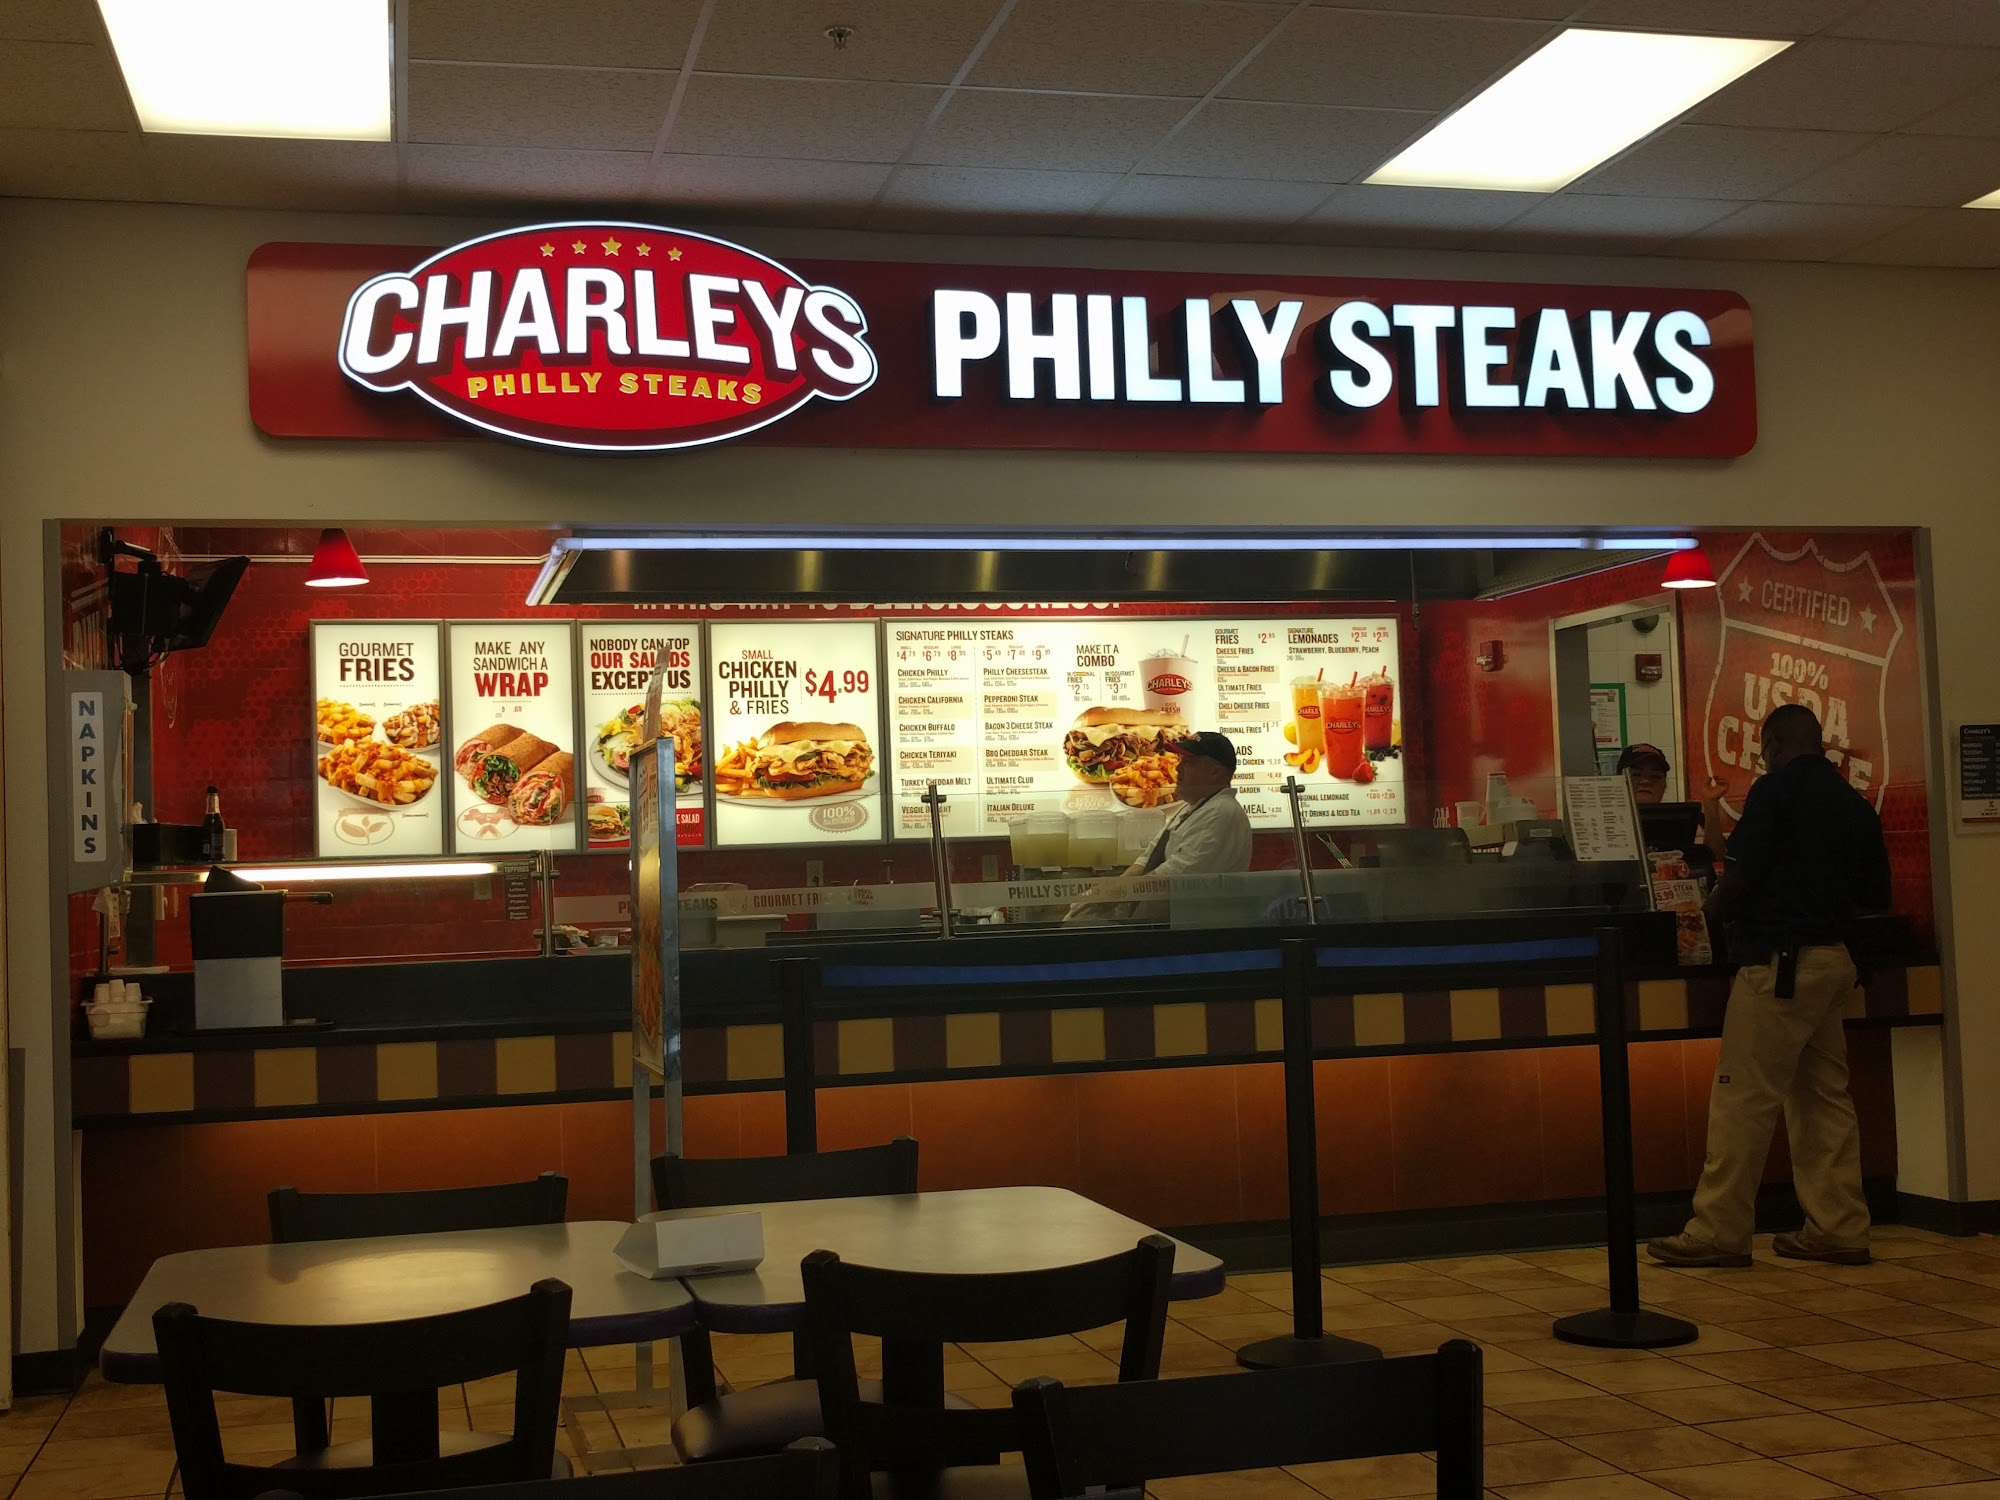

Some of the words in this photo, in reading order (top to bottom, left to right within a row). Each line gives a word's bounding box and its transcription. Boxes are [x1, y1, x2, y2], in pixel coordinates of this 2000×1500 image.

[348, 267, 875, 385] CHARLEYS
[933, 289, 1304, 404] PHILLY
[1327, 300, 1715, 414] STEAKS
[467, 372, 602, 398] PHILLY
[620, 373, 763, 405] STEAKS
[1760, 580, 1851, 627] CERTIFIED
[896, 630, 945, 641] SIGNATURE
[947, 630, 978, 640] PHILLY
[980, 630, 1014, 640] STEAKS
[1215, 634, 1239, 644] FRIES
[1288, 633, 1339, 644] LEMONADES
[339, 642, 414, 657] GOURMET
[475, 641, 512, 655] MAKE
[519, 641, 545, 655] ANY
[590, 638, 638, 651] NOBODY
[641, 638, 664, 650] CAN
[667, 638, 690, 650] TOP
[1076, 644, 1101, 654] MAKE
[1103, 644, 1111, 654] IT
[1113, 644, 1119, 654] A
[1288, 646, 1327, 654] STRAWBERRY,
[1328, 646, 1361, 654] BLUEBERRY,
[1362, 645, 1379, 653] PEACH
[741, 649, 774, 660] SMALL
[1216, 647, 1237, 655] CHEESE
[1238, 647, 1254, 655] FRIES
[473, 657, 537, 671] SANDWICH
[540, 657, 548, 670] A
[590, 652, 624, 669] OUR
[630, 651, 690, 669] SALDS
[1077, 655, 1115, 667] COMBO
[340, 658, 415, 681] FRIES
[718, 660, 797, 679] CHICKEN
[897, 668, 925, 677] CHICKEN
[926, 668, 948, 676] PHILLY
[983, 667, 1004, 676] PHILLY
[1006, 667, 1048, 676] CHEESESTEAK
[1217, 665, 1236, 673] CHEESE
[1242, 665, 1259, 673] BACON
[1769, 652, 1829, 690] 100%
[474, 672, 548, 697] WRAP
[667, 670, 691, 689] US
[1146, 677, 1193, 691] CHARLEYS
[729, 680, 789, 698] PHILLY
[805, 668, 869, 703] $4.99
[1246, 683, 1262, 691] FRIES
[898, 696, 926, 704] CHICKEN
[927, 695, 964, 704] CALIFORNIA
[984, 695, 1018, 703] PEPPERONI
[1019, 694, 1039, 702] STEAK
[729, 700, 742, 715] &
[747, 700, 789, 714] FRIES
[1255, 701, 1270, 709] FRIES
[899, 723, 926, 732] CHICKEN
[928, 723, 956, 731] BUFFALO
[985, 722, 1005, 730] BACON
[1006, 721, 1010, 730] 3
[1011, 721, 1033, 730] CHEESE
[1034, 721, 1053, 729] STEAK
[1219, 726, 1245, 734] ORIGINAL
[1325, 720, 1360, 729] CHARLEYS
[900, 751, 927, 759] CHICKEN
[929, 750, 957, 759] TERIYAKI
[999, 748, 1028, 757] CHEDDAR
[1029, 748, 1049, 756] STEAK
[78, 700, 98, 854] NAPKINS
[901, 778, 924, 786] TURKEY
[955, 777, 971, 785] MELT
[986, 776, 1016, 785] ULTIMATE
[1017, 775, 1034, 784] CLUB
[1320, 793, 1350, 801] LEMONADE
[823, 806, 855, 818] 100%
[901, 806, 924, 814] VEGGIE
[986, 804, 1010, 812] ITALIAN
[1011, 803, 1035, 811] DELUXE
[1243, 804, 1267, 814] MEAL
[1309, 809, 1330, 817] DRINKS
[1350, 808, 1361, 816] TEA
[681, 813, 700, 824] SALAD
[1008, 885, 1051, 899] PHILLY
[1672, 884, 1694, 892] STEAK
[753, 893, 803, 907] GOURMET
